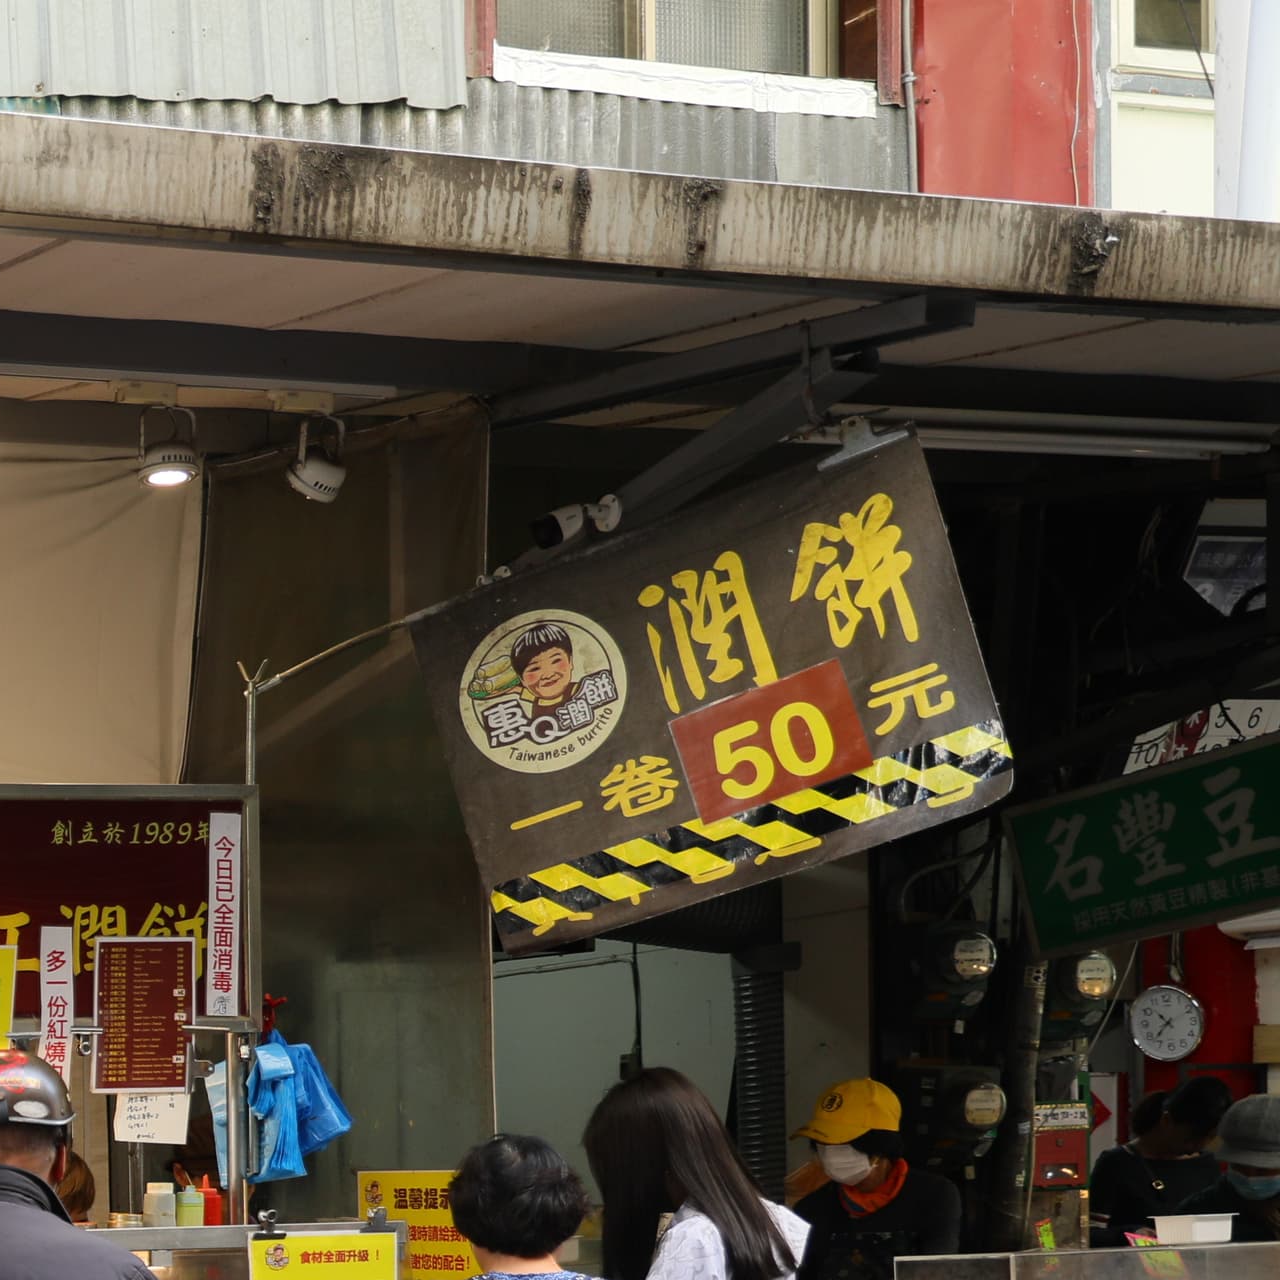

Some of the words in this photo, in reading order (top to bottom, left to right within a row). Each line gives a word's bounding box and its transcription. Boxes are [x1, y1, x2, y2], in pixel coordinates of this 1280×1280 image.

[637, 493, 919, 714] 潤餅
[482, 672, 617, 747] 惠Q潤餅
[508, 742, 576, 762] Taiwanese
[578, 706, 614, 747] burrito
[1247, 707, 1263, 730] 6
[212, 836, 236, 994] 今日已全面消毒
